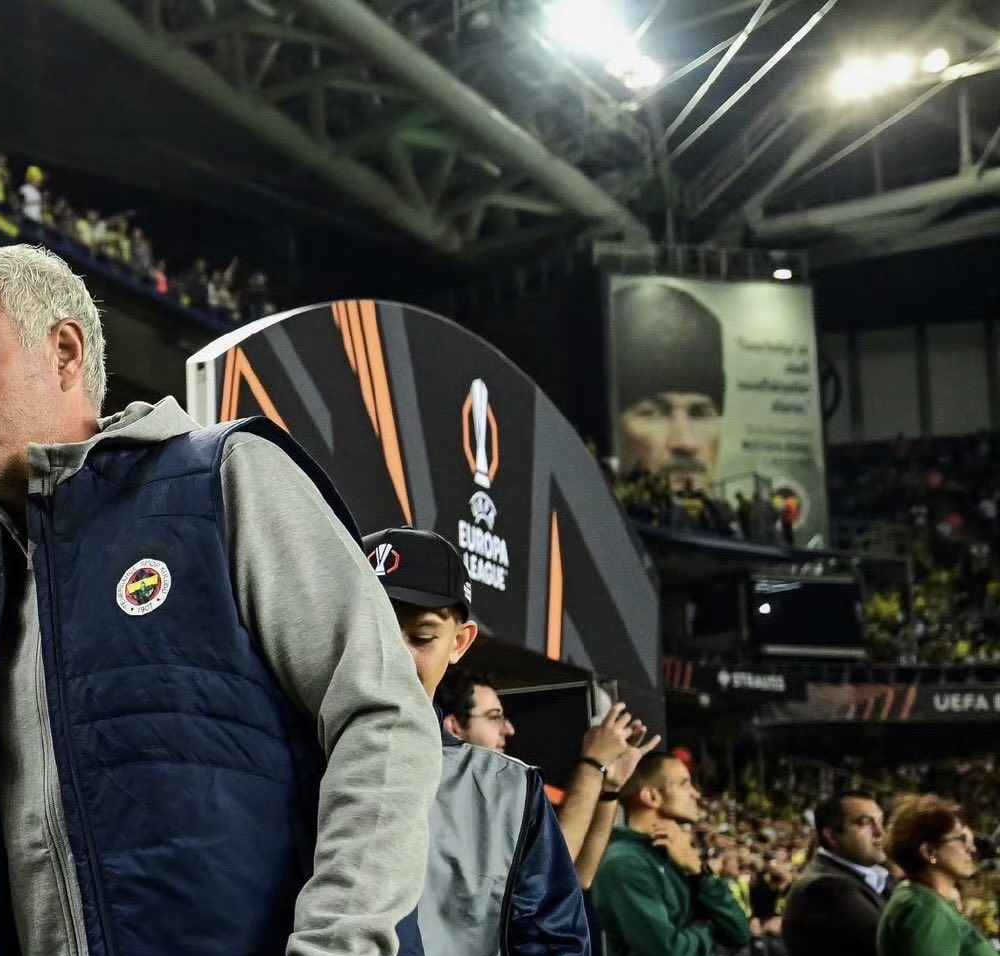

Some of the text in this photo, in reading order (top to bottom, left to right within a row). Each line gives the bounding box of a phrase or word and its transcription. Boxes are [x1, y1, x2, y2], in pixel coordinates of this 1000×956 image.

[458, 519, 509, 569] EUROPA
[463, 550, 507, 592] LEAGUE
[933, 692, 990, 712] UEFA
